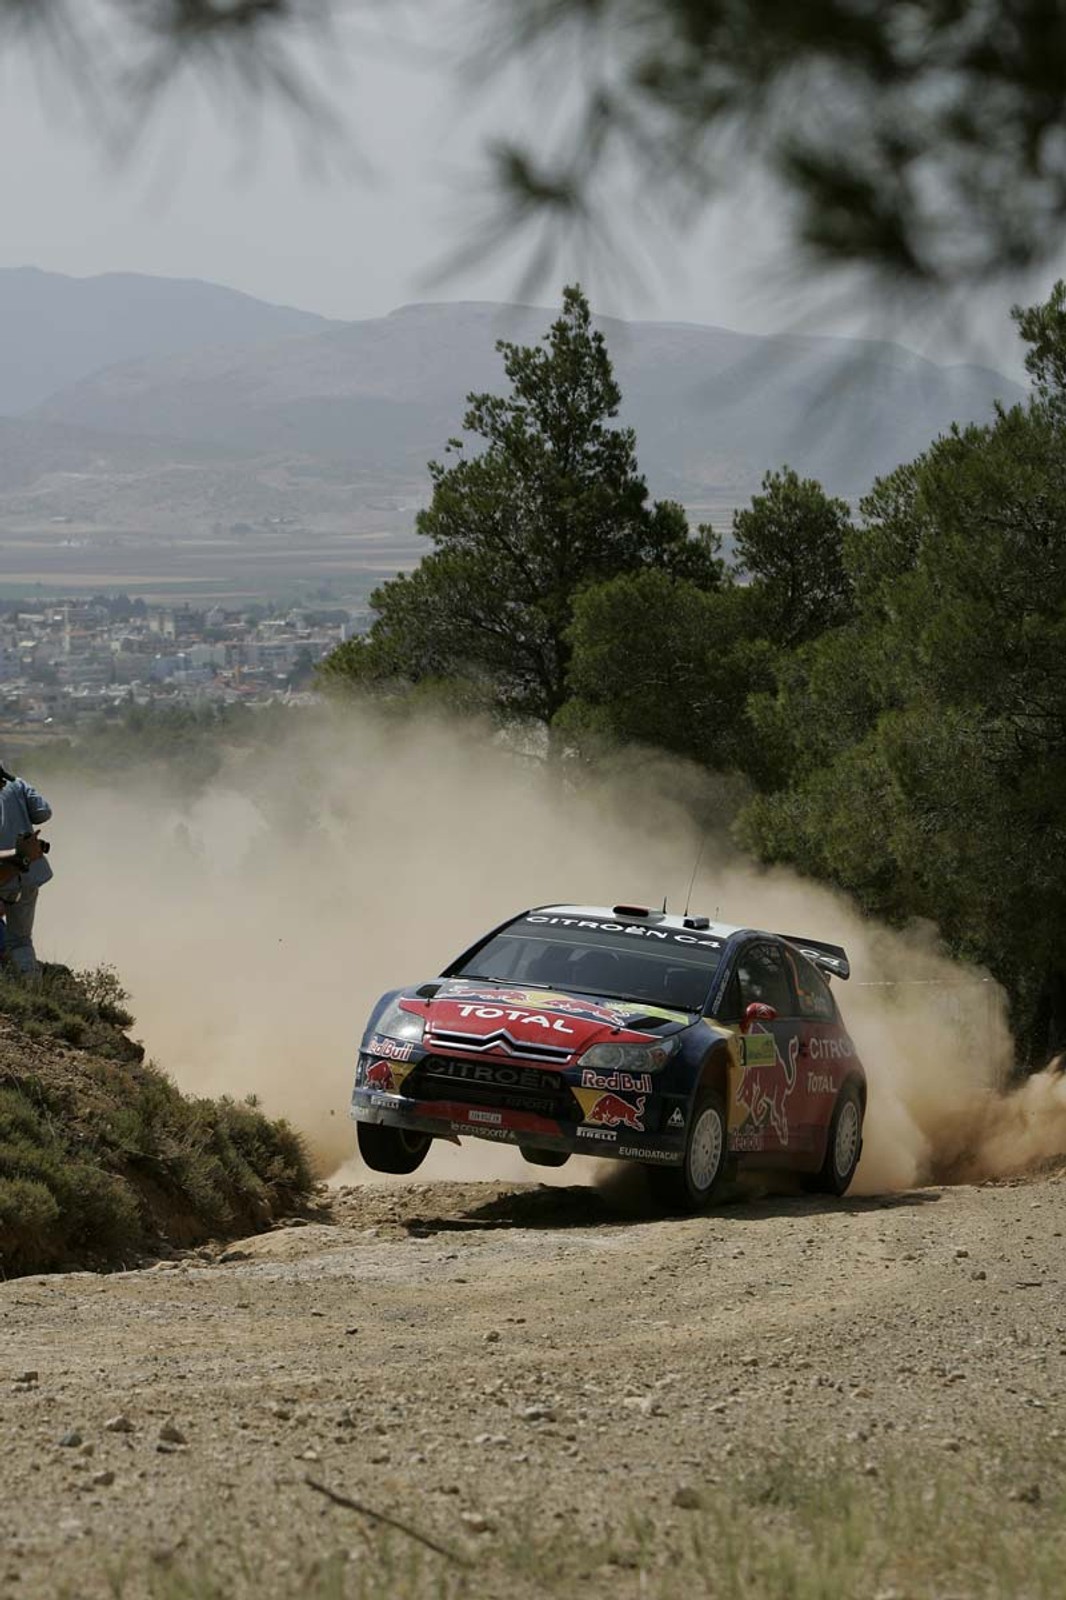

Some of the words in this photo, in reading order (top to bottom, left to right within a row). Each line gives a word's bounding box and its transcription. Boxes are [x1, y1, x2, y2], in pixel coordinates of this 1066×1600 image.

[526, 915, 668, 939] CITROËN
[674, 934, 721, 948] C4
[458, 1004, 574, 1034] TOTAL
[425, 1056, 562, 1089] CITROËN
[581, 1069, 620, 1091] Red
[620, 1073, 653, 1093] Bull
[807, 1071, 838, 1094] TOTAL
[576, 1126, 618, 1141] PIRELLI
